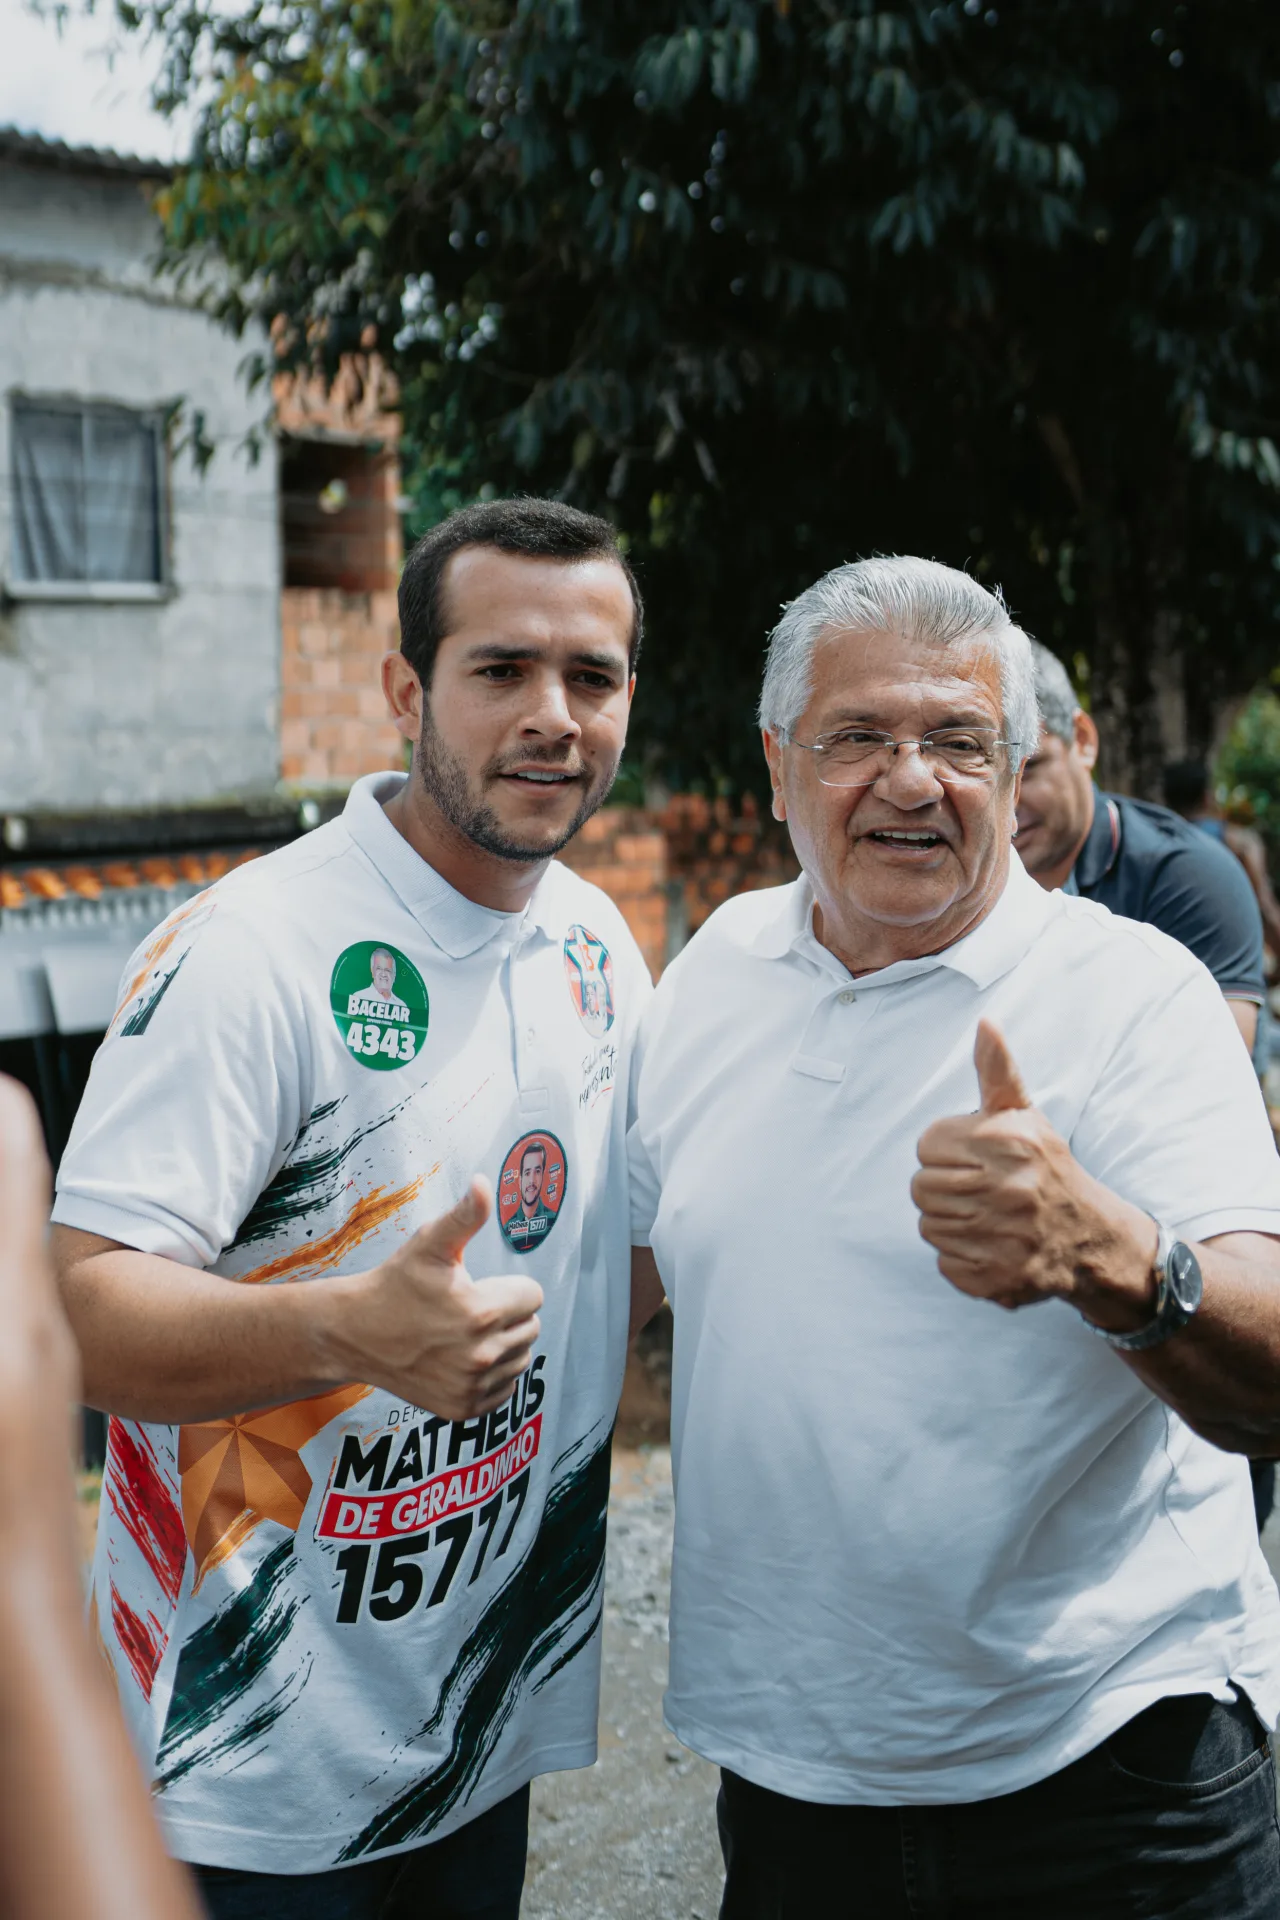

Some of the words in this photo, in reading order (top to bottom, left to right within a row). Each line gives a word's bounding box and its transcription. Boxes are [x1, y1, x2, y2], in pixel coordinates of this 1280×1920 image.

[346, 1022, 416, 1061] 4343
[347, 995, 410, 1023] BACELAR
[333, 1354, 547, 1492] MATHEUS
[334, 1501, 385, 1535] DE
[391, 1425, 535, 1531] GERALDINHO
[335, 1466, 531, 1624] 15777
